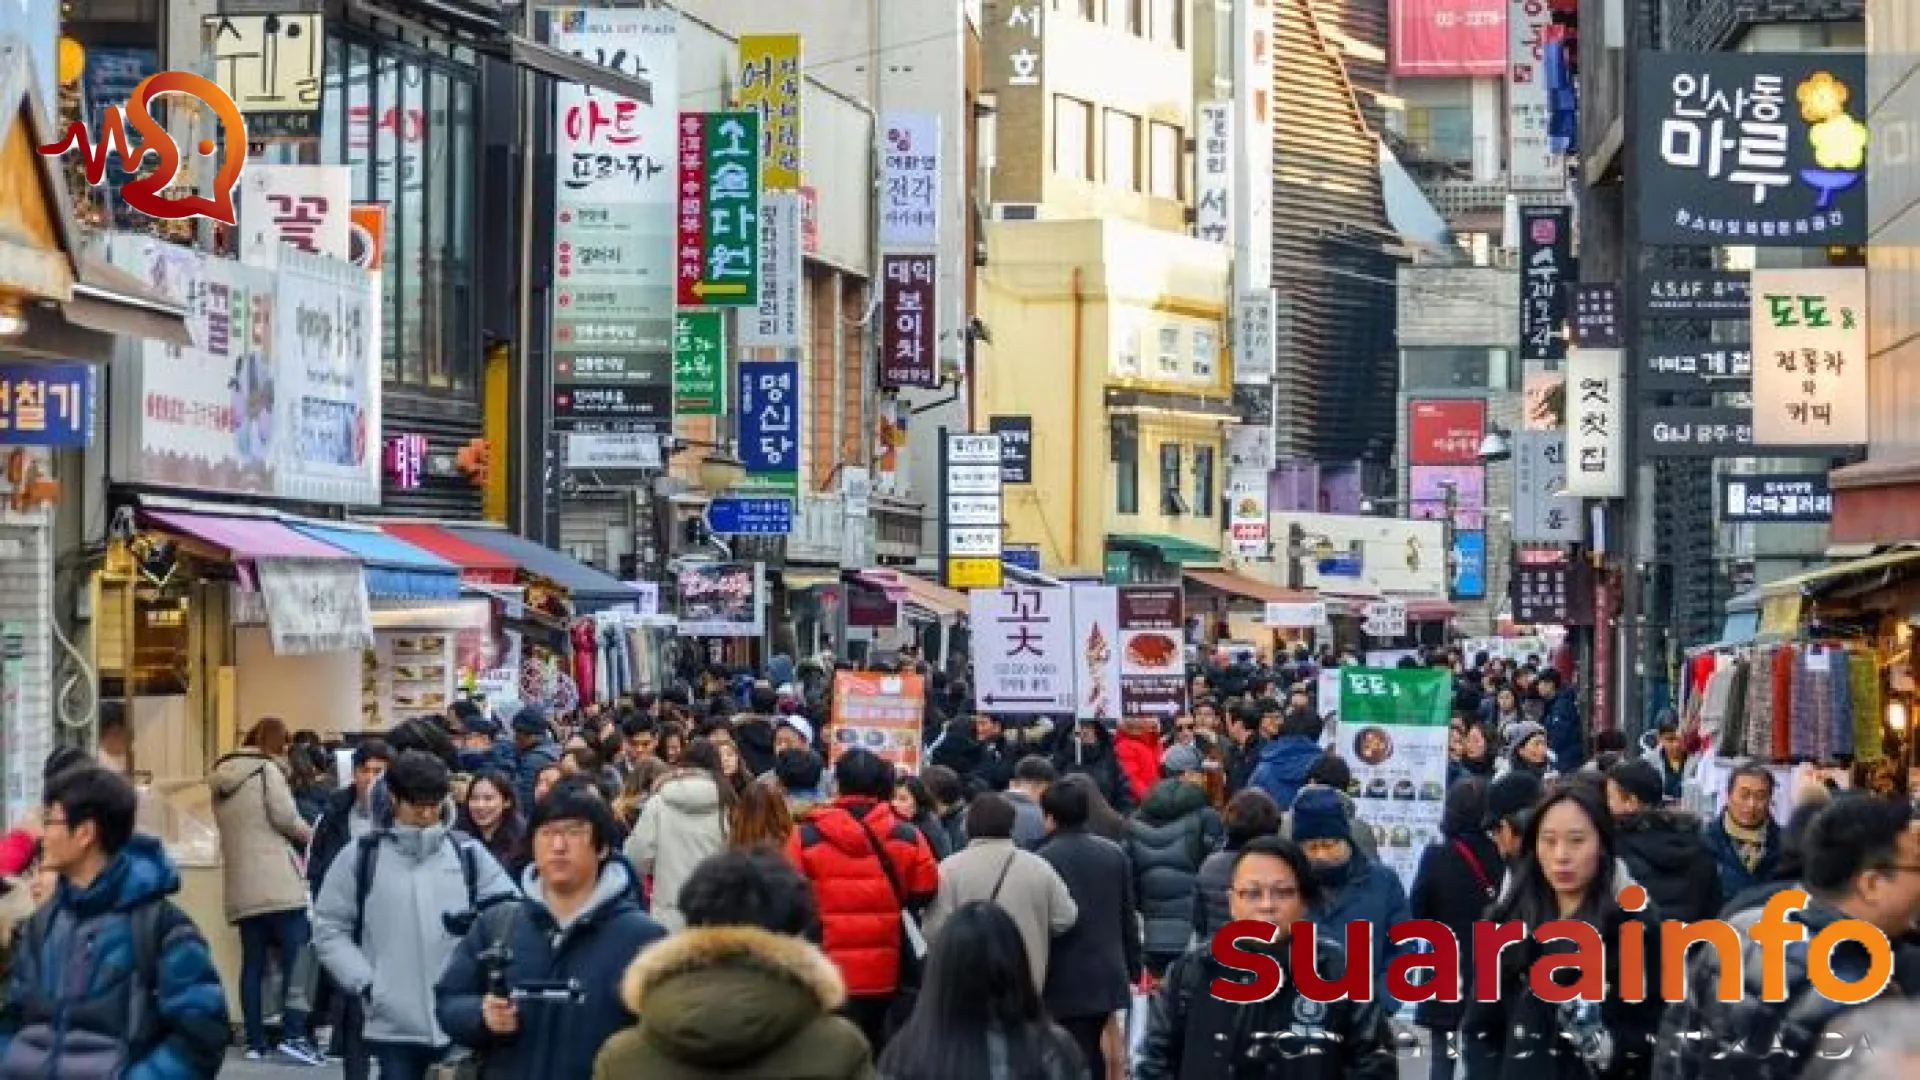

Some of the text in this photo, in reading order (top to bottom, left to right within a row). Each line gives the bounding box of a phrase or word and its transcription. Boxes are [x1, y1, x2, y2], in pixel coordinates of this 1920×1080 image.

[1673, 72, 1785, 121] 인사동
[565, 100, 641, 145] 아트
[564, 152, 663, 189] 프라자
[1661, 118, 1791, 204] 마루
[888, 259, 931, 285] 대익
[895, 290, 926, 363] 보이차
[1763, 293, 1832, 327] 도도
[1773, 347, 1848, 376] 전통차
[759, 373, 793, 464] 명신당
[1579, 377, 1611, 474] 옛찻집
[1786, 402, 1831, 425] 커피
[997, 587, 1050, 657] 꽃
